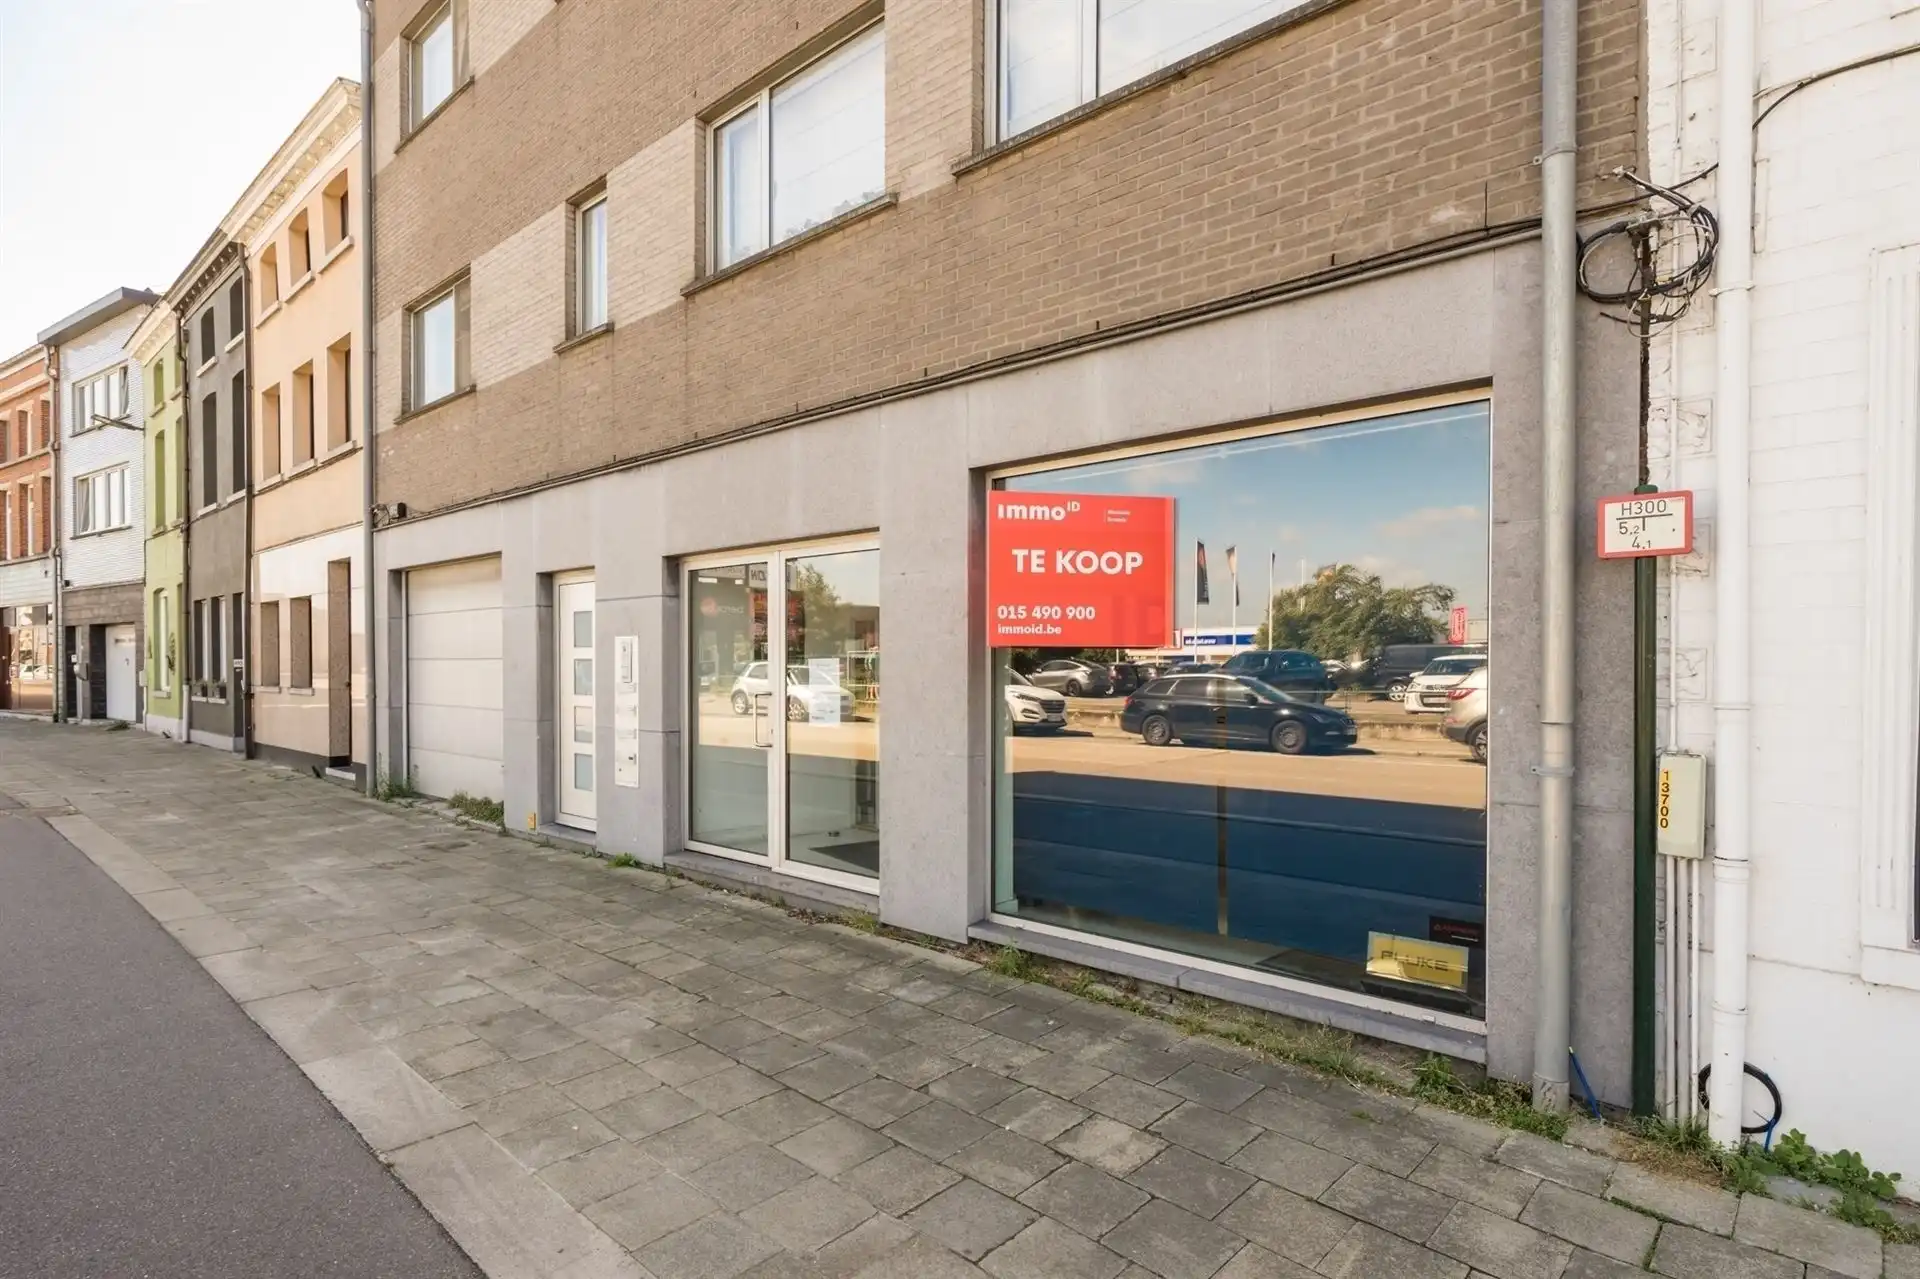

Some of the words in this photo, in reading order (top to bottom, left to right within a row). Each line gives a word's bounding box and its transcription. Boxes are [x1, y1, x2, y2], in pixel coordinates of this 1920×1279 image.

[1621, 500, 1667, 516] H300
[1012, 549, 1046, 573] TE
[1056, 550, 1144, 575] KOOP
[997, 606, 1028, 620] 015
[1032, 606, 1061, 620] 490
[1066, 606, 1096, 620] 900
[998, 624, 1062, 635] immoid.be
[1660, 771, 1670, 828] 13700
